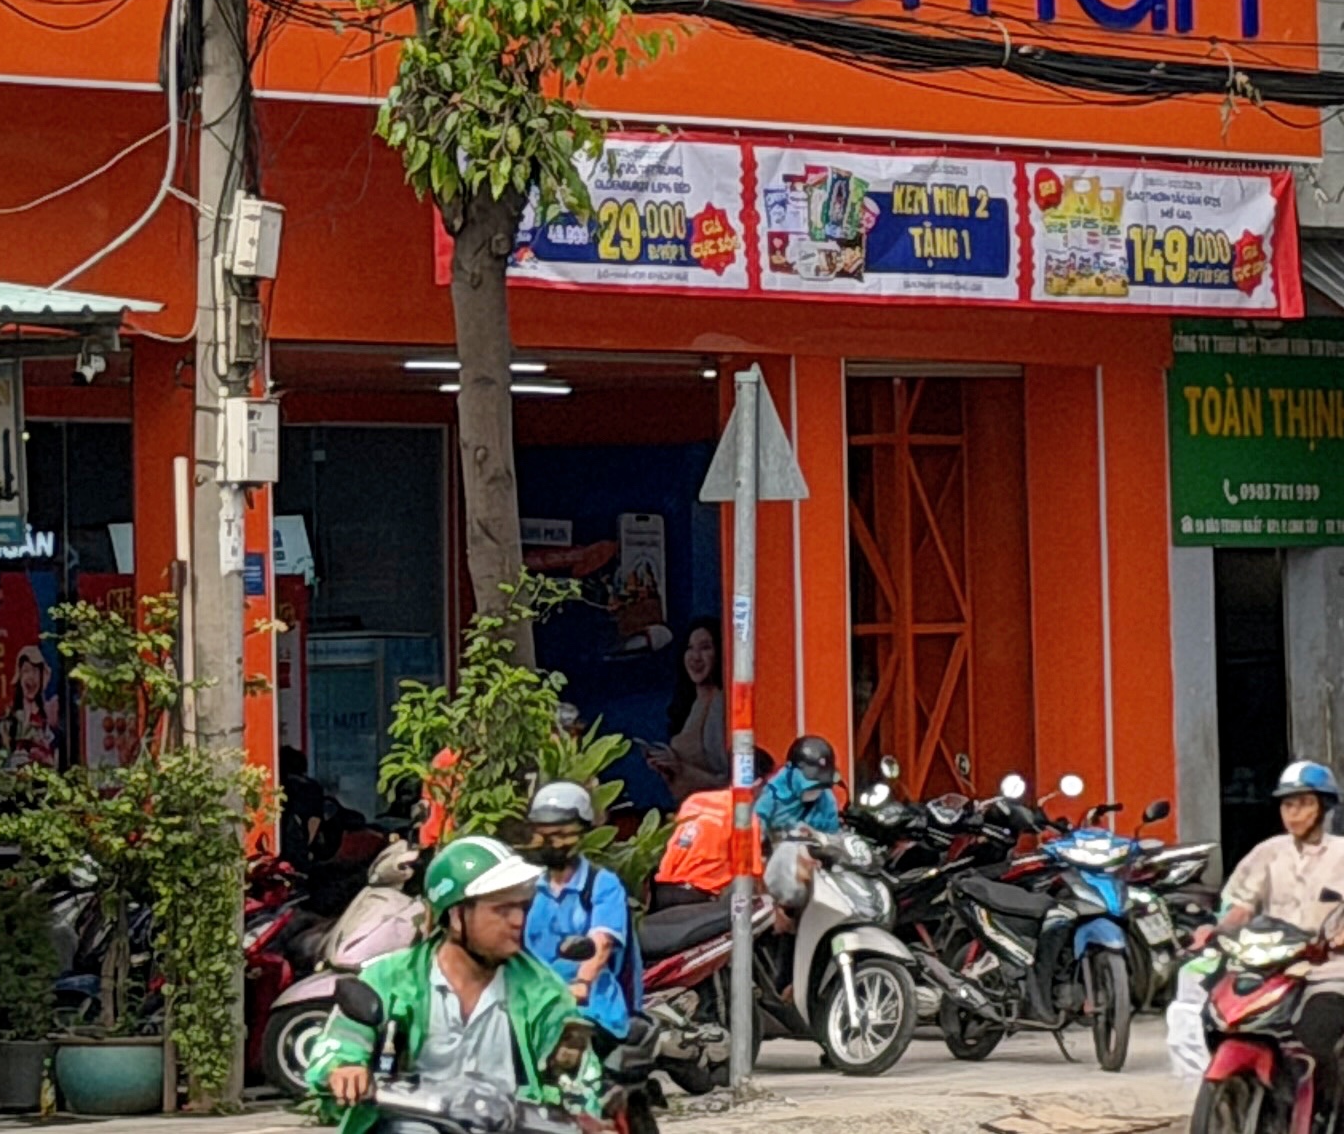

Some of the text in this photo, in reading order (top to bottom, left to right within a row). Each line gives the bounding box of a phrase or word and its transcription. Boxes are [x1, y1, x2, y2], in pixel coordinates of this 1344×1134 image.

[892, 182, 990, 218] KEM MUA 2
[597, 200, 687, 262] 29.000
[908, 220, 972, 268] TẶNG 1
[1129, 226, 1231, 284] 149.000
[1183, 372, 1264, 437] TOÀN
